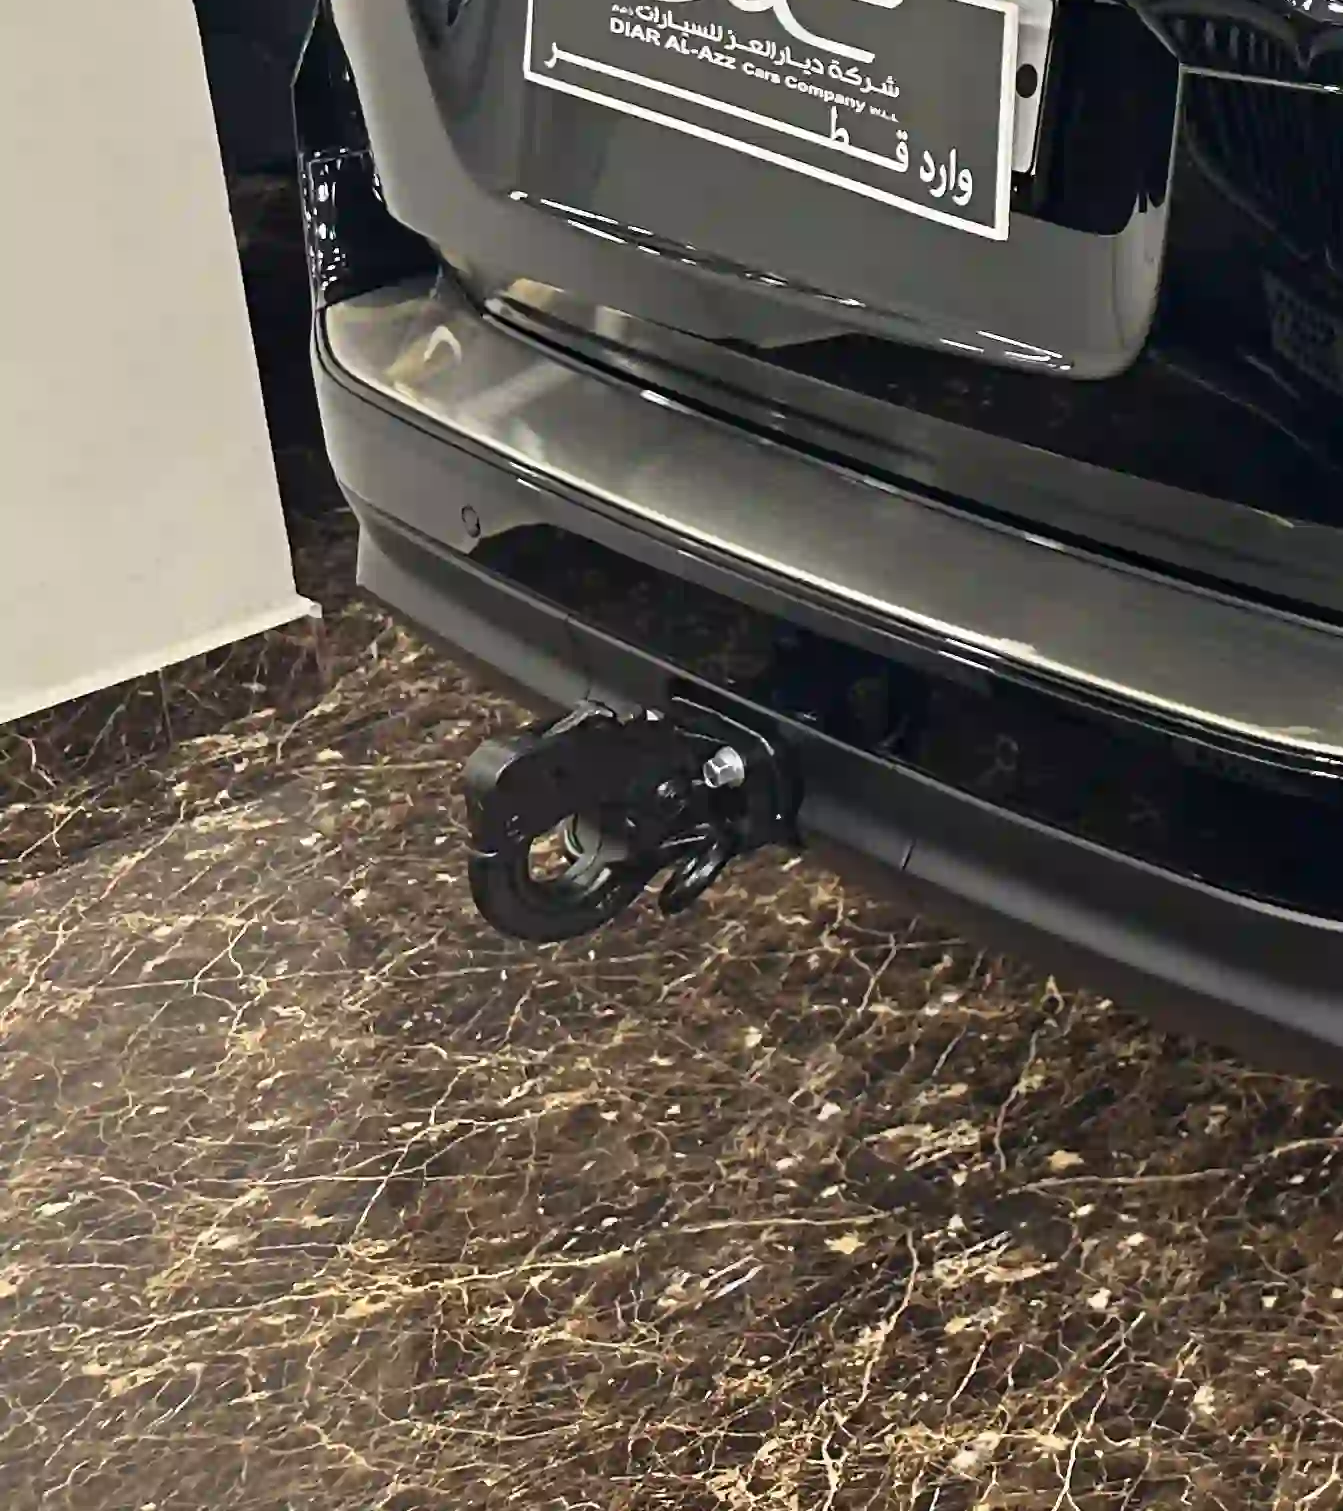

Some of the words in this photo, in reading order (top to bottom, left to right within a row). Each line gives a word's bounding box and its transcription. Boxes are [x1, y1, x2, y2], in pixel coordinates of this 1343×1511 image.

[609, 16, 661, 47] DIAR
[742, 61, 781, 84] Cars
[784, 75, 866, 113] Company
[773, 45, 824, 75] ديار
[827, 58, 900, 98] شركة
[918, 147, 974, 206] وارد
